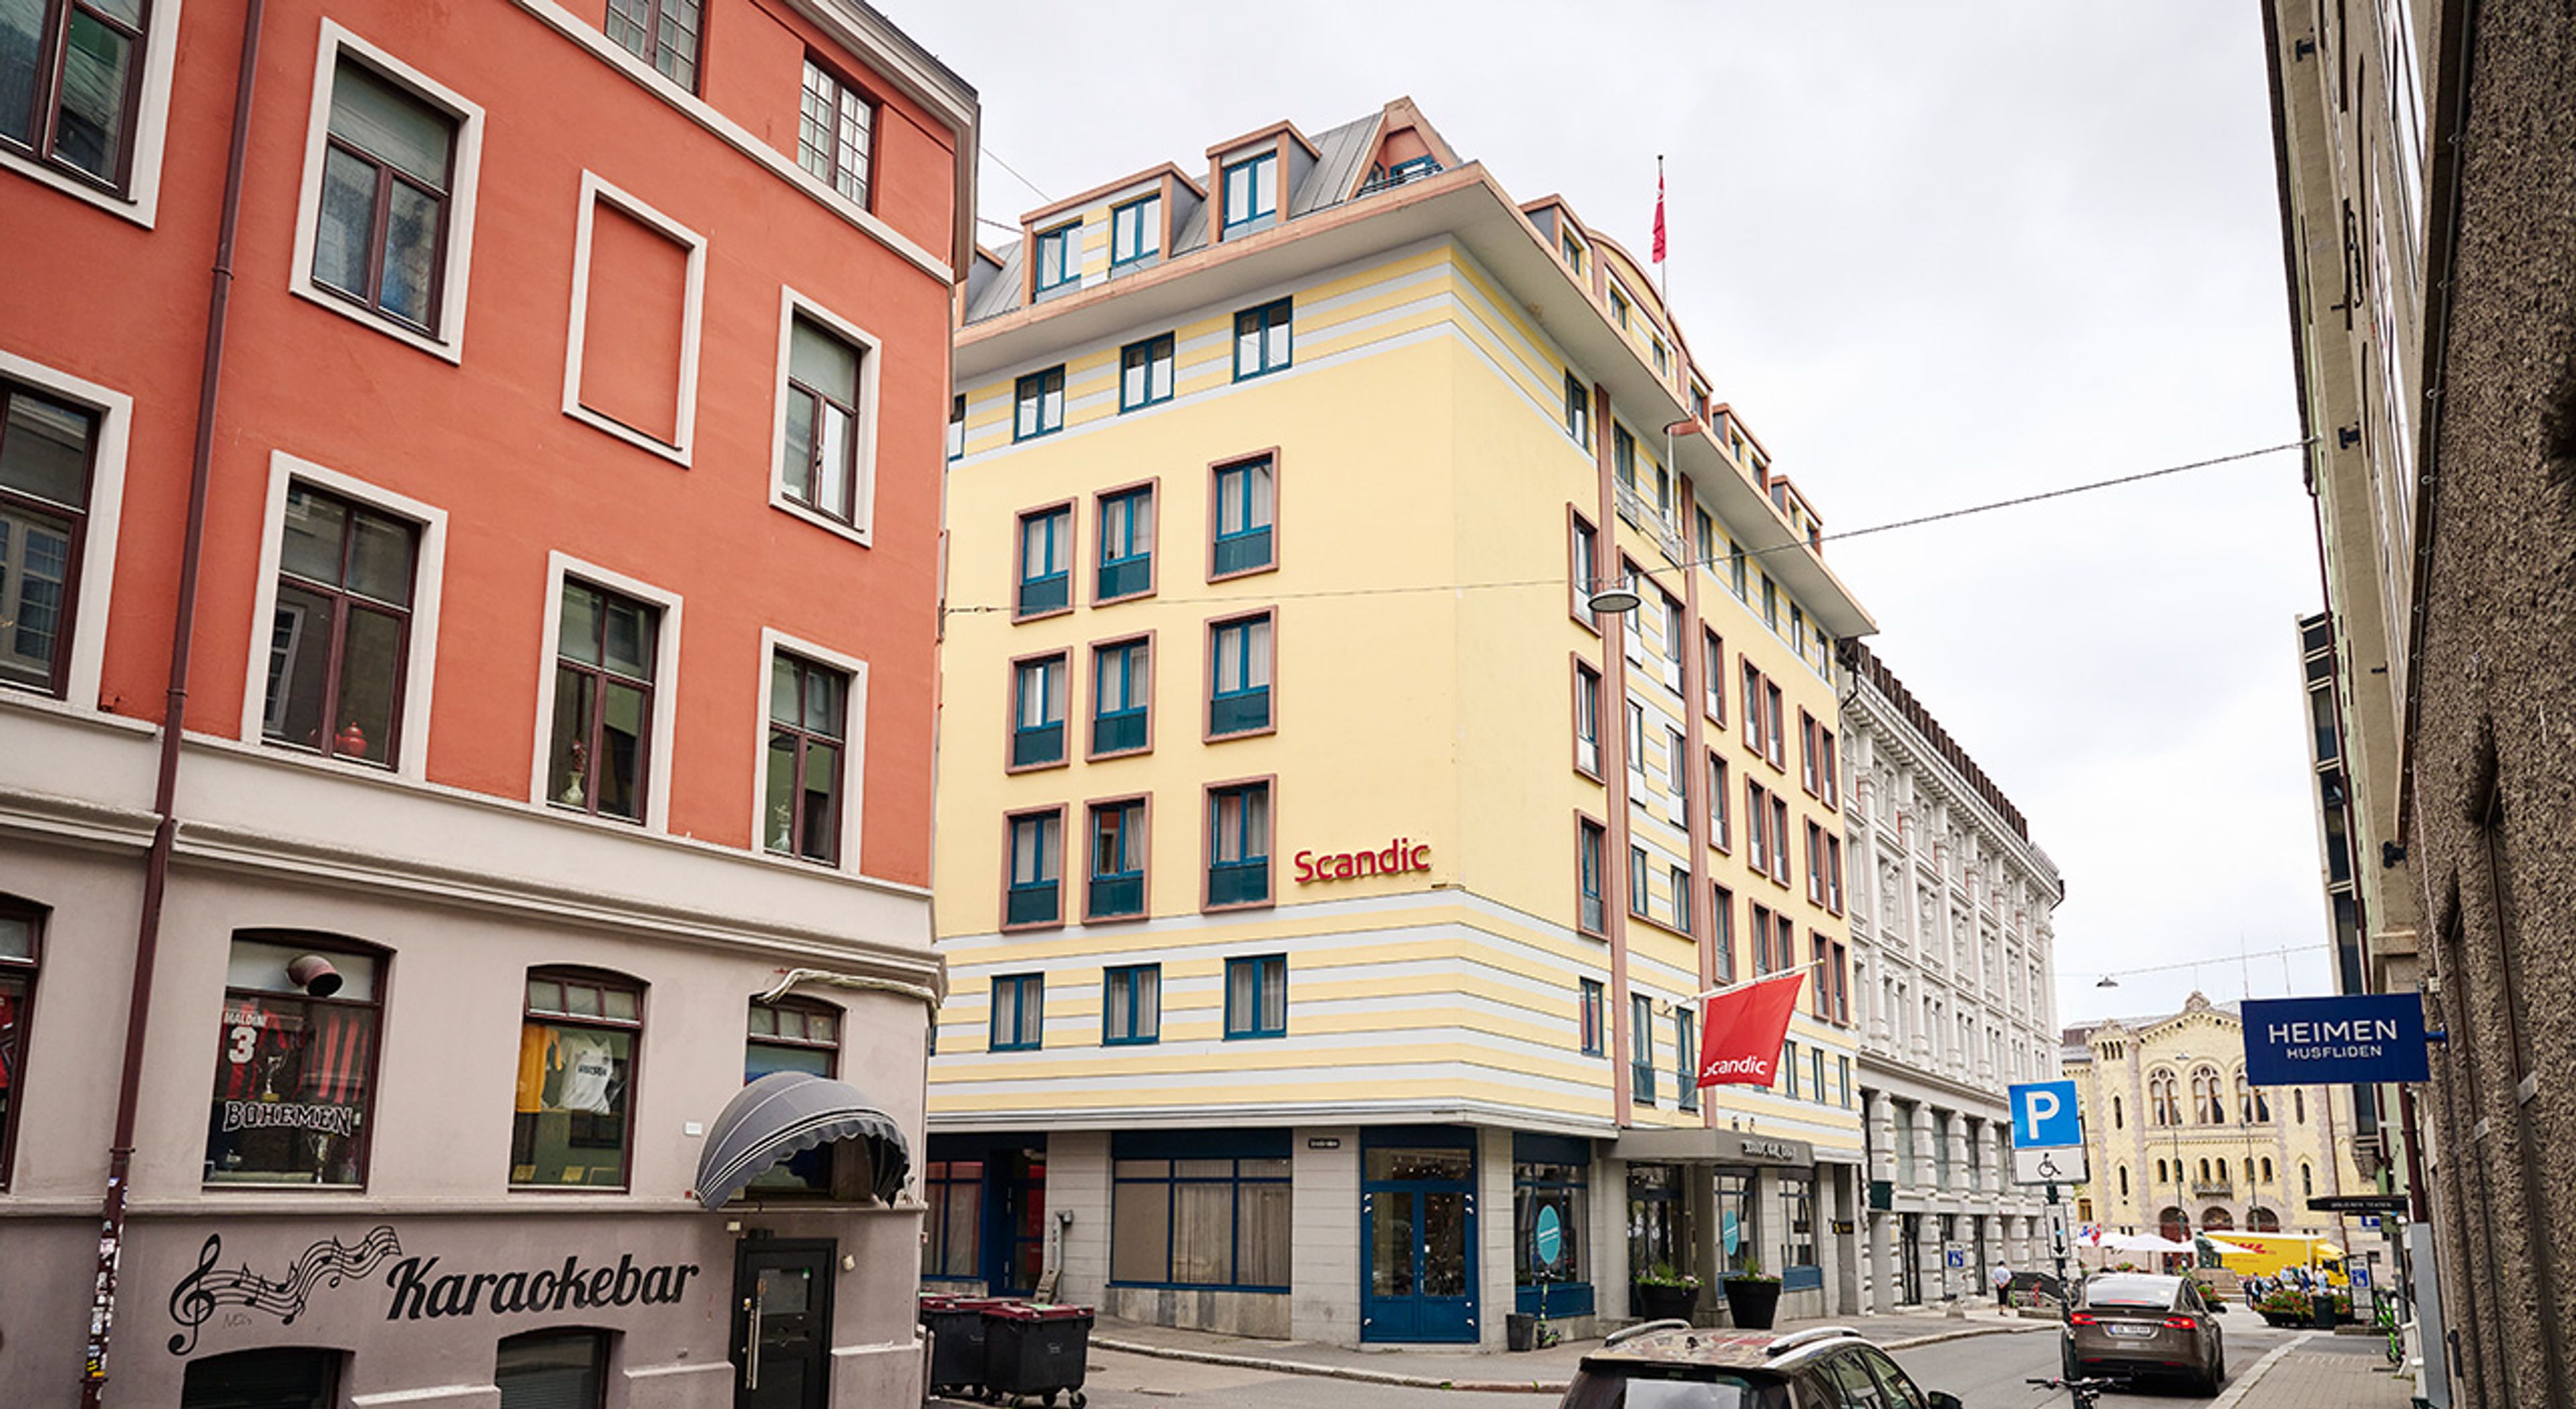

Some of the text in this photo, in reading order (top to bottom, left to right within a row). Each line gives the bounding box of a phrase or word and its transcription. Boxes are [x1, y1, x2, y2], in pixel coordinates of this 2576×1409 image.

[1294, 837, 1429, 882] Scandic
[228, 1026, 257, 1063] 3
[2268, 1019, 2398, 1044] HEIMEN
[2286, 1045, 2382, 1059] HUSFLIDEN
[223, 1100, 353, 1137] BOHEMEN
[2025, 1090, 2060, 1140] P
[386, 1253, 700, 1320] Karaokebar
